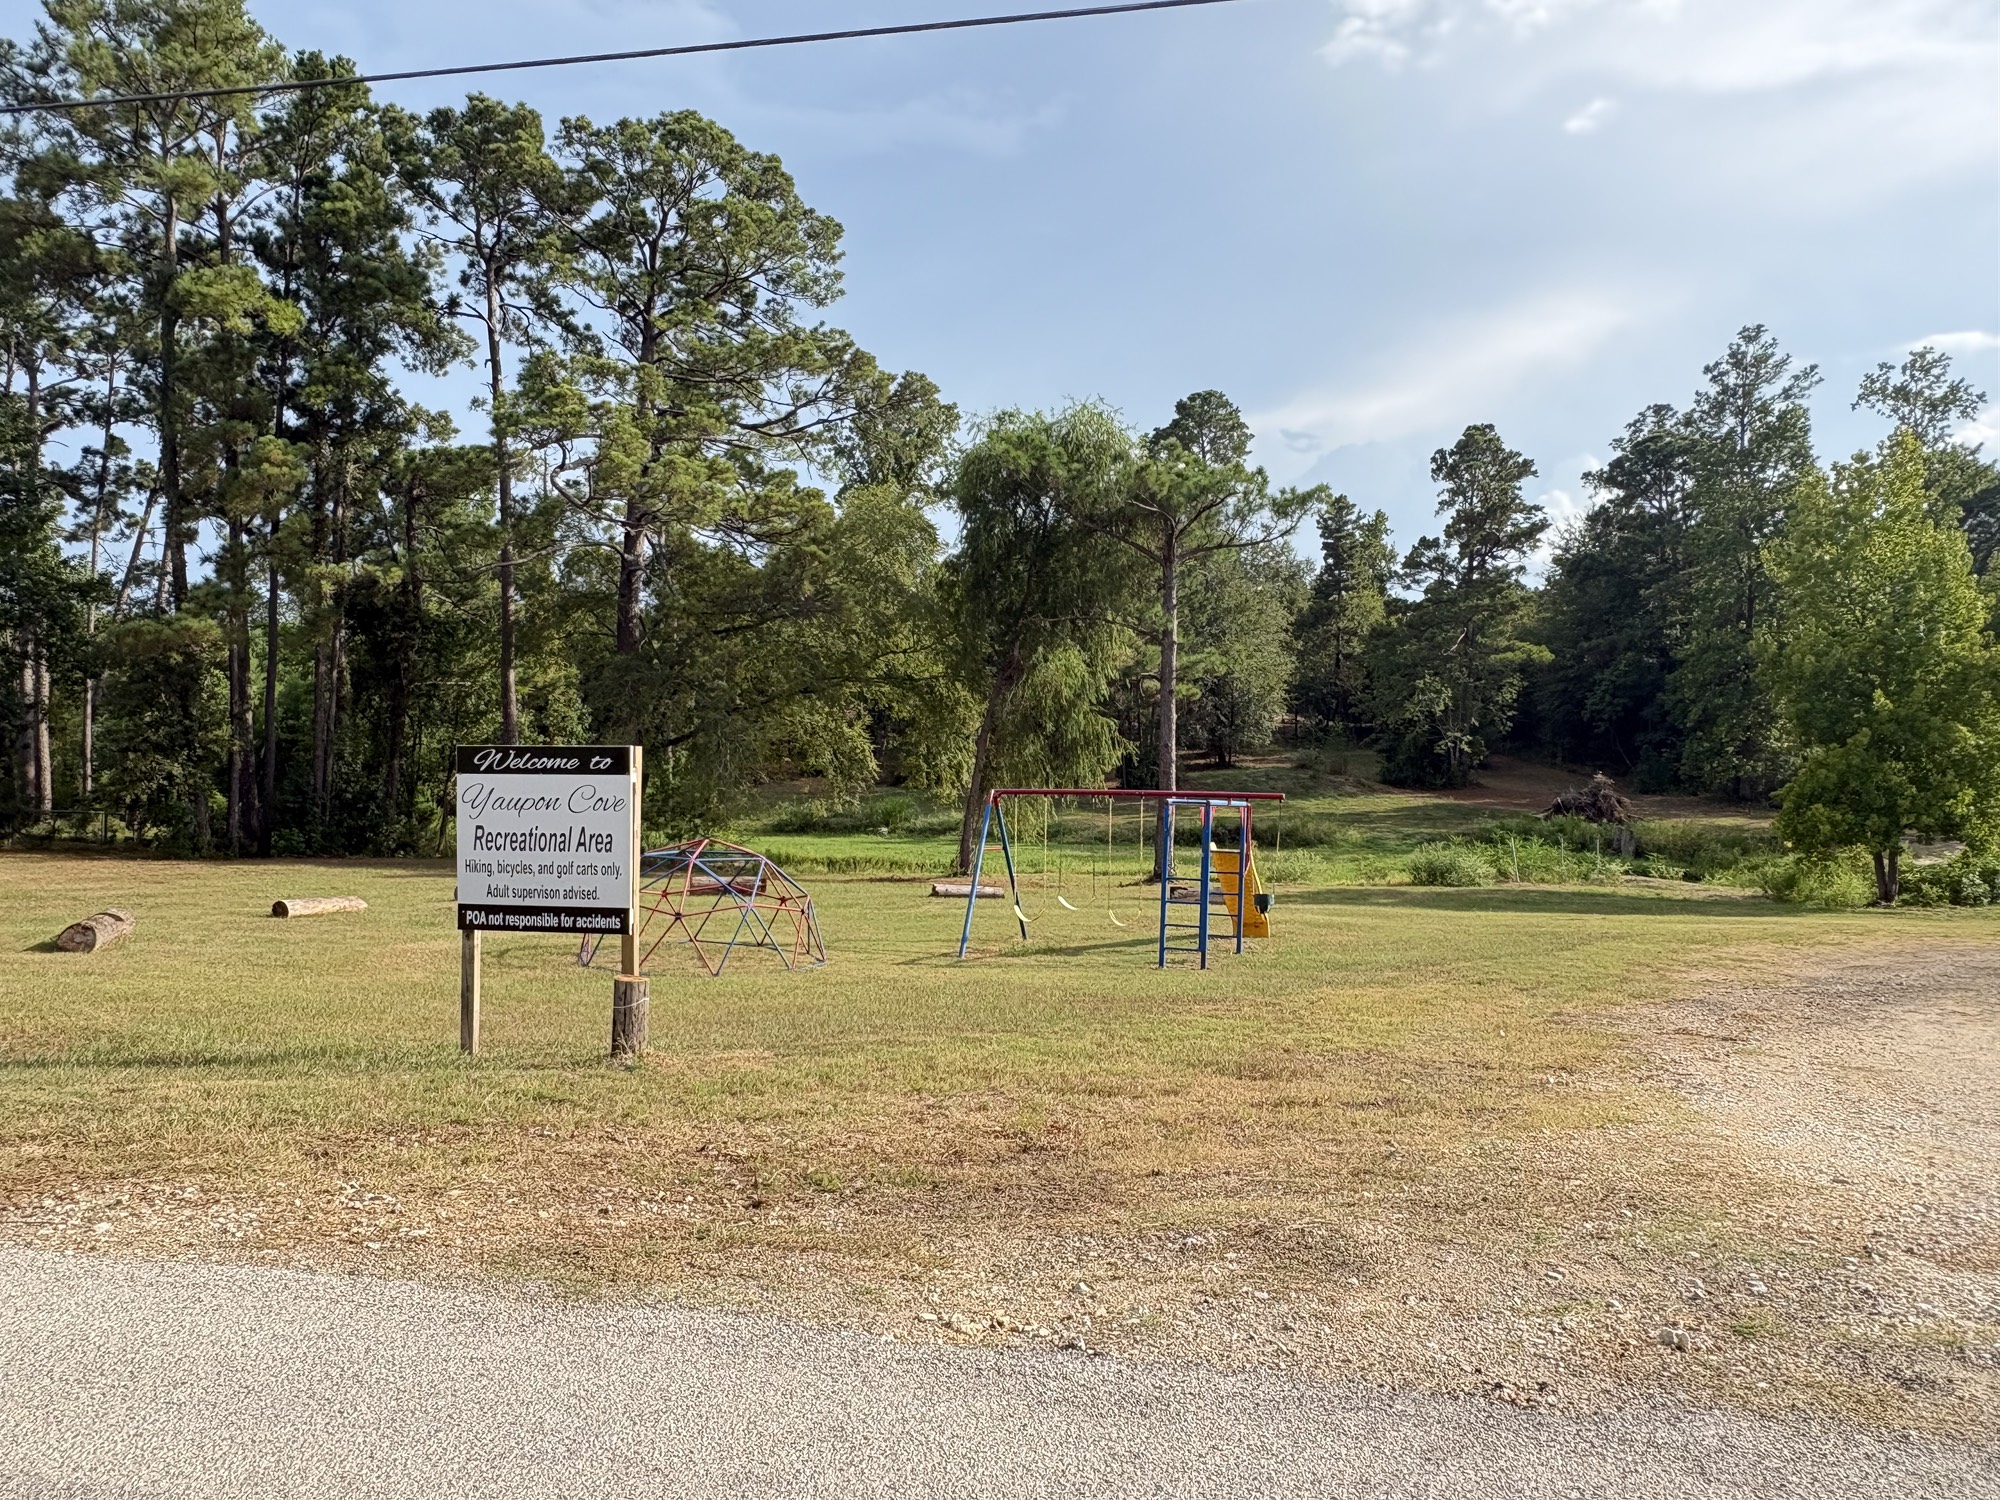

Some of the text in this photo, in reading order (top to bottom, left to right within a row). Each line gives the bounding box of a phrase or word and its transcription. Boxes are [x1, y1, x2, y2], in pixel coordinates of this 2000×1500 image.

[474, 749, 613, 771] Welcome to
[461, 783, 626, 819] Yaupon Cove
[474, 825, 613, 853] Recreational Area
[465, 859, 622, 879] Hiking, bicycles, and golf carts only.
[486, 884, 509, 898] Adult
[563, 886, 599, 900] advised.
[466, 910, 620, 929] POA not responsible for accidents
